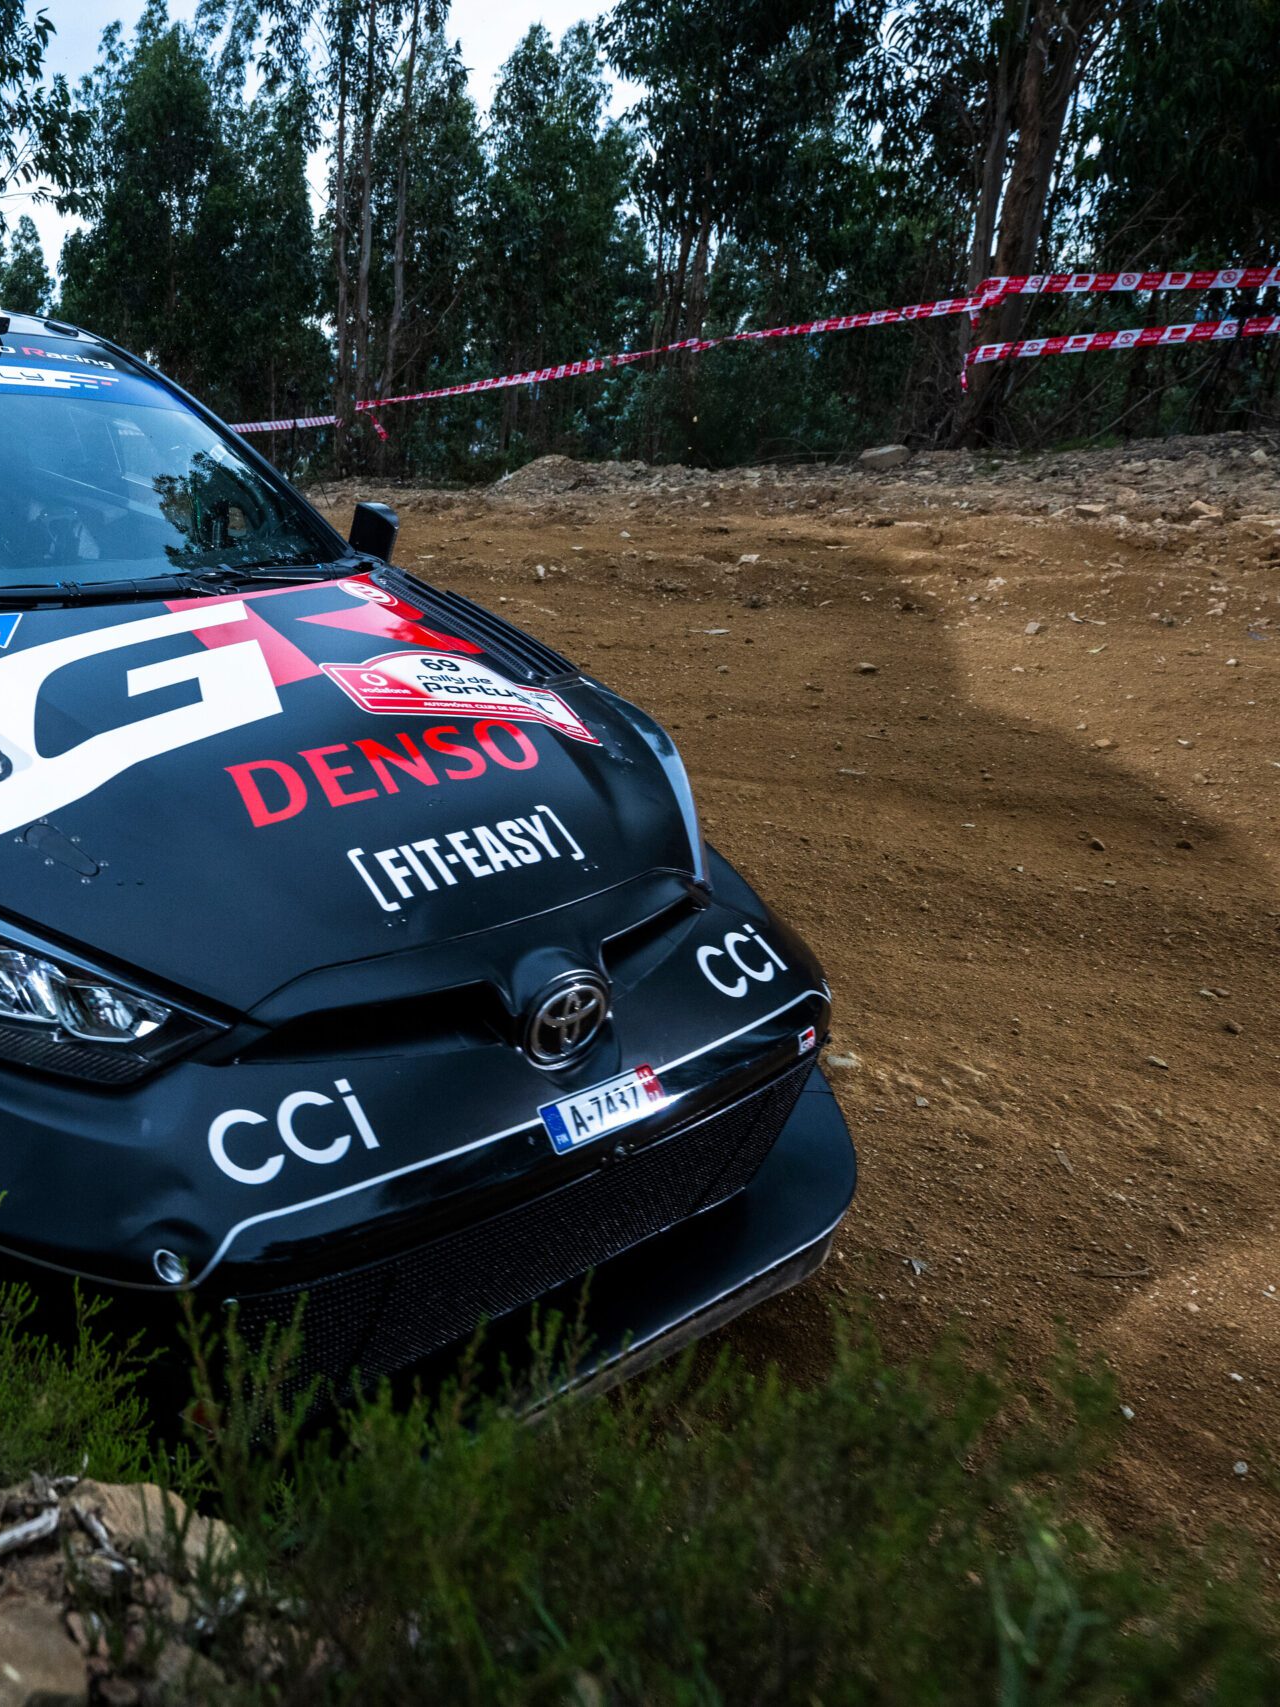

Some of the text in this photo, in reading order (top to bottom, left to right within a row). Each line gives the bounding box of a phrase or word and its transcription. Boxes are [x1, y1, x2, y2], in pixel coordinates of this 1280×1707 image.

[21, 347, 116, 370] Racing
[421, 658, 460, 672] 69
[416, 675, 493, 685] rally de
[422, 682, 553, 714] Portul
[224, 719, 539, 828] DENSO
